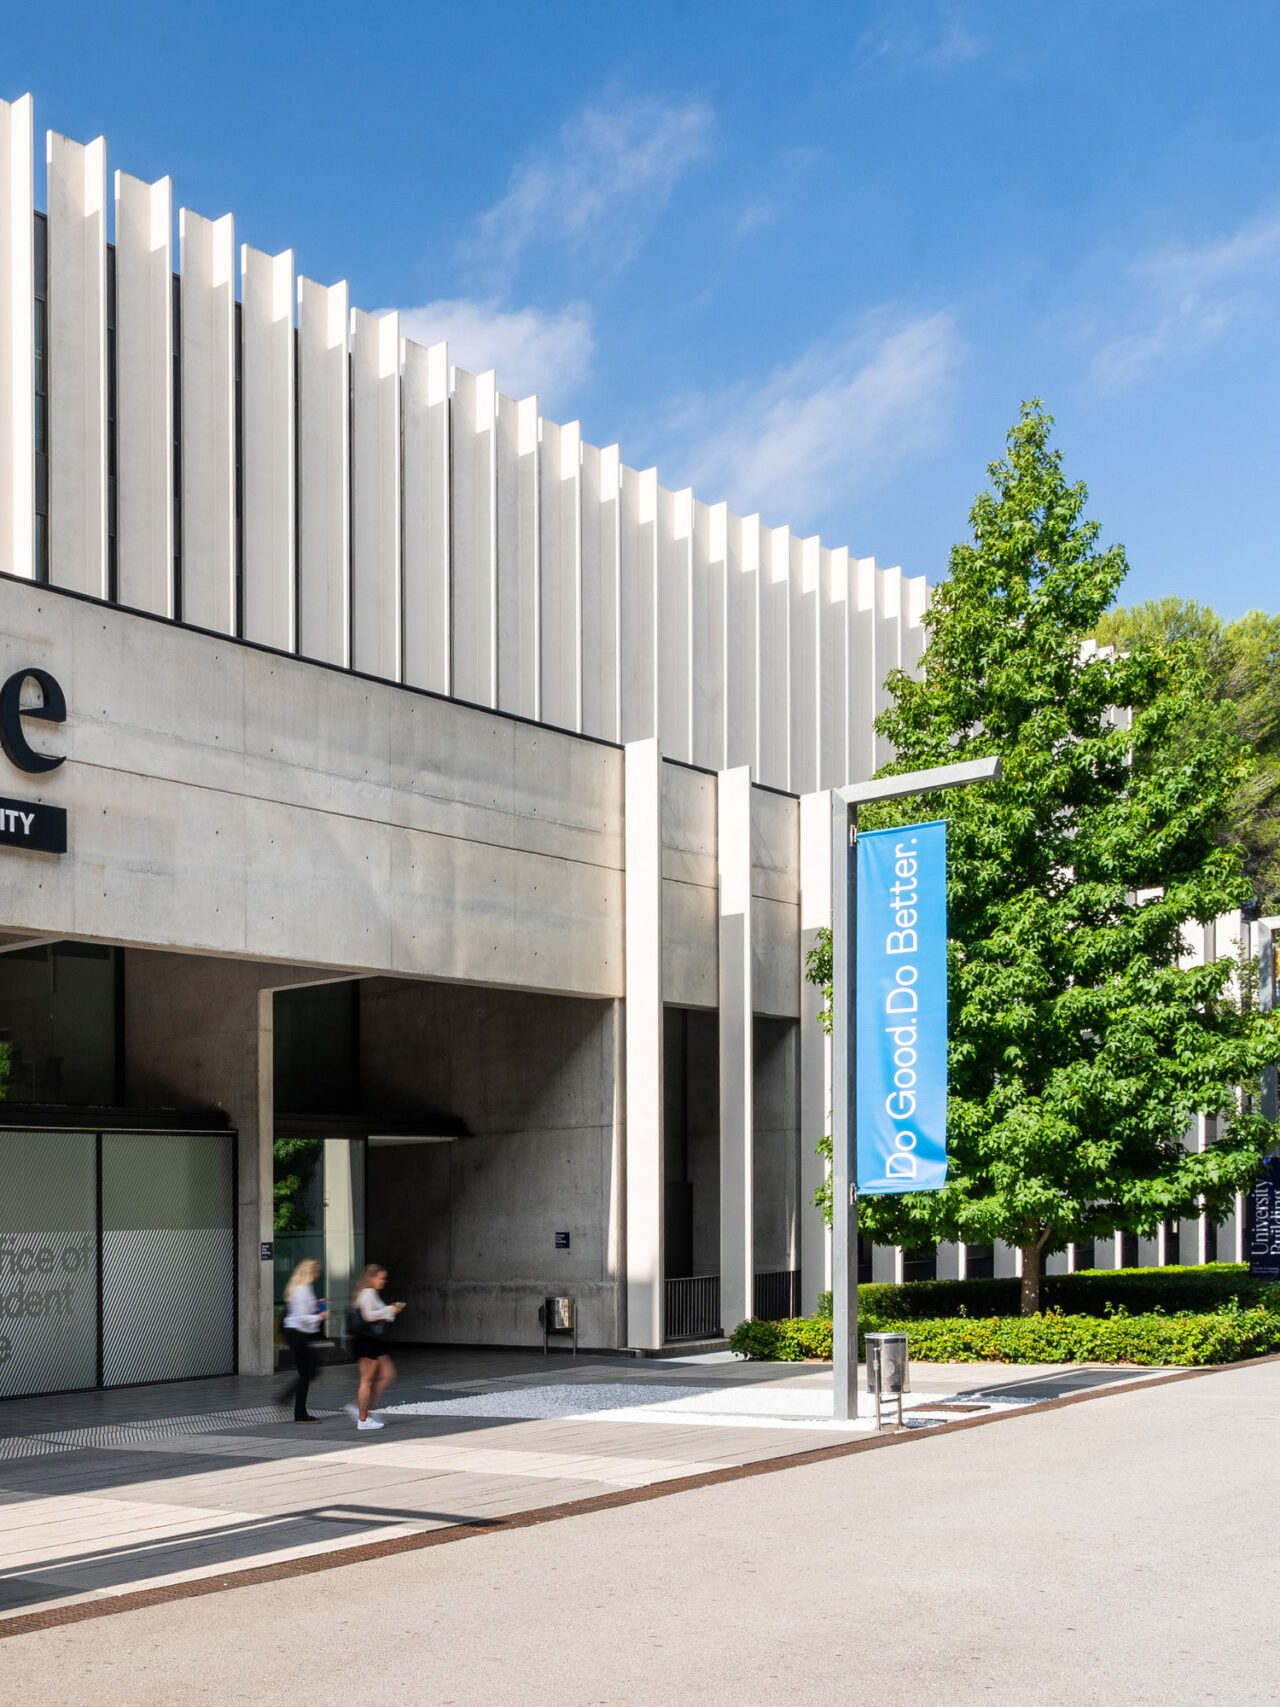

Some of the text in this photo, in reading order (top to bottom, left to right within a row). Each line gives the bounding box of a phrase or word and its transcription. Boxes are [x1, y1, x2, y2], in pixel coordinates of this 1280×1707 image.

[885, 837, 918, 1180] Do Good. Do Better.
[1251, 1179, 1273, 1255] University
